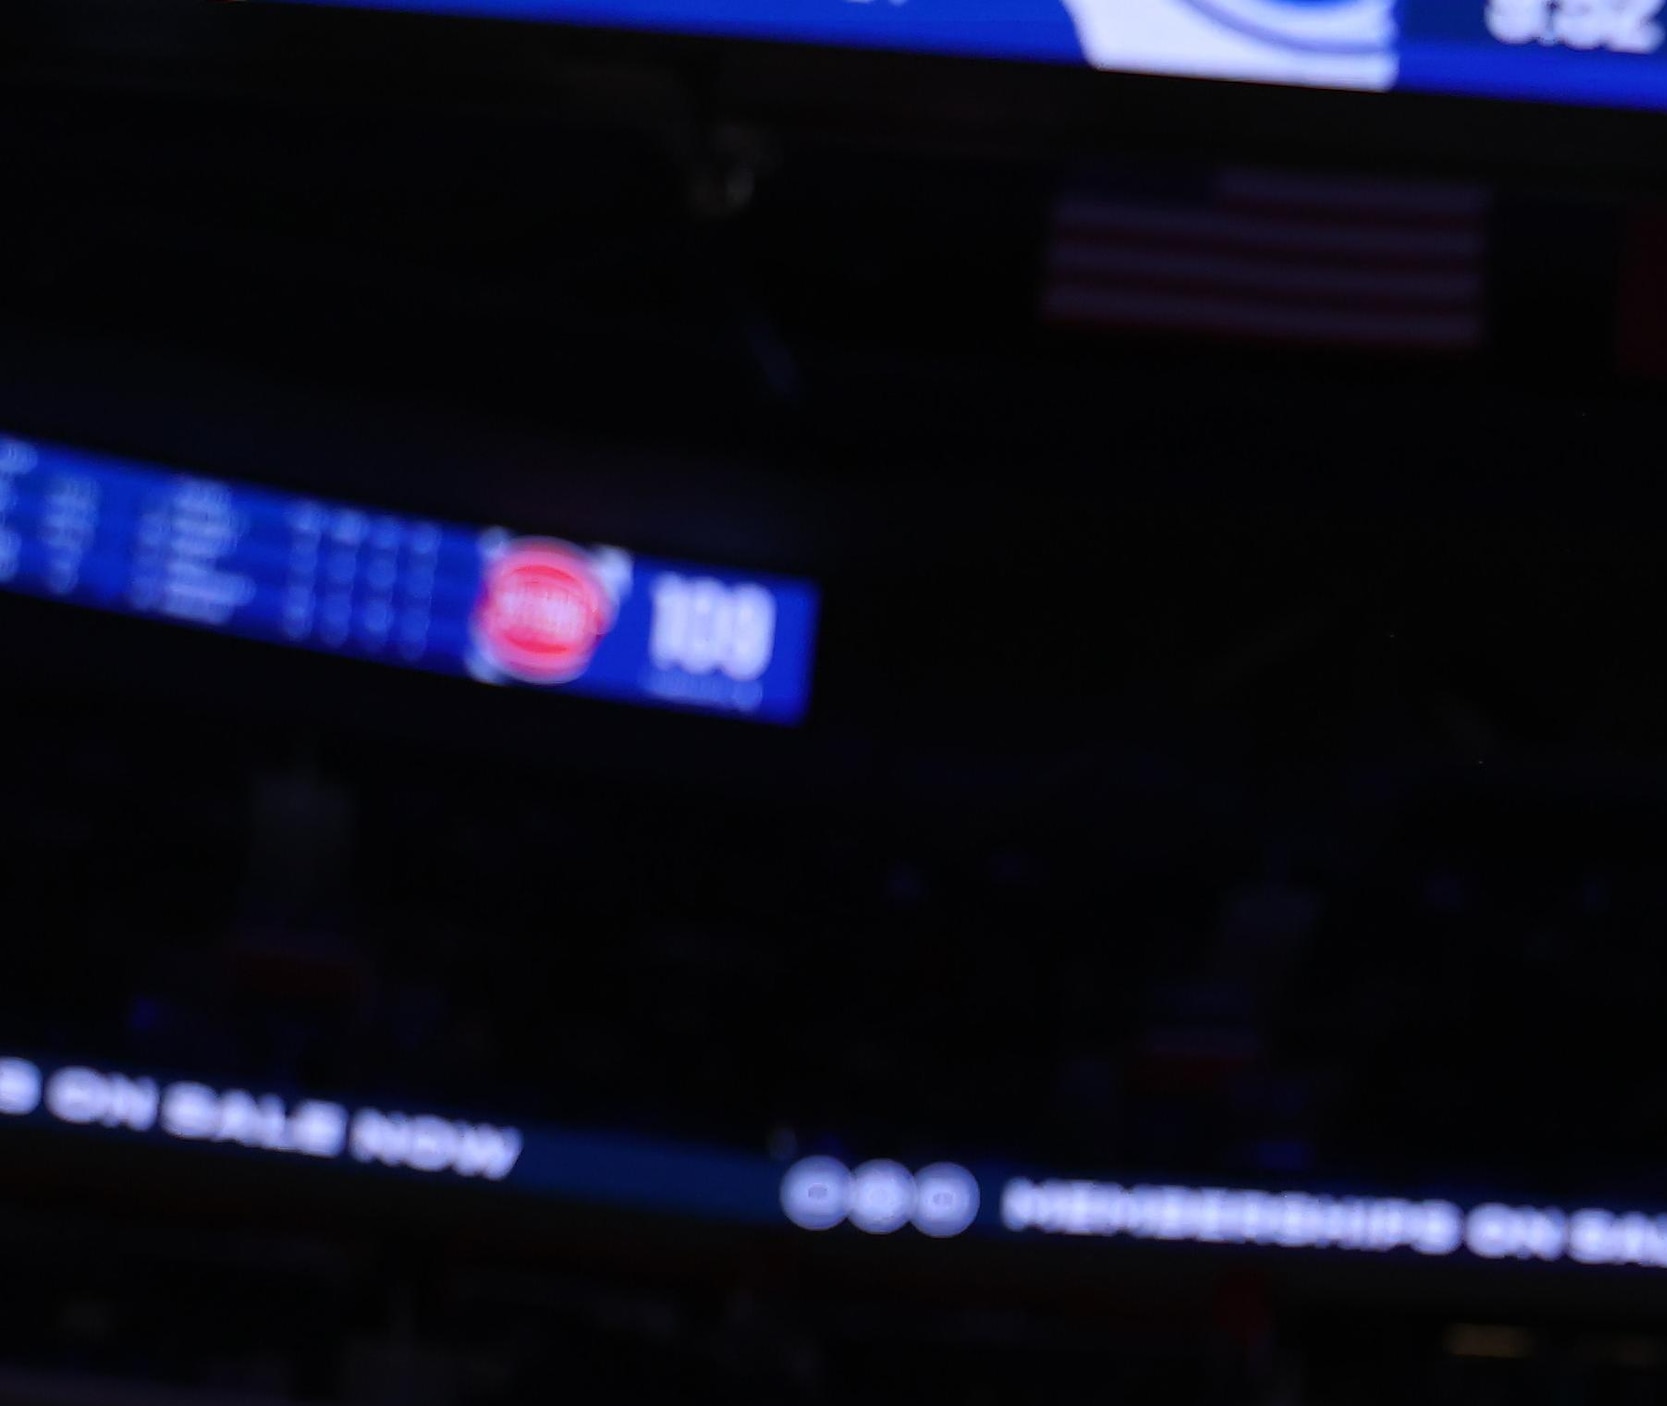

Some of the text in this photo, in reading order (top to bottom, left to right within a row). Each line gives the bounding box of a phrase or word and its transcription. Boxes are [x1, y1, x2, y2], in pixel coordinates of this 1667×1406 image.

[46, 1066, 159, 1131] ON
[161, 1083, 347, 1159] SALE
[349, 1107, 522, 1180] NOW
[1465, 1202, 1566, 1261] ON
